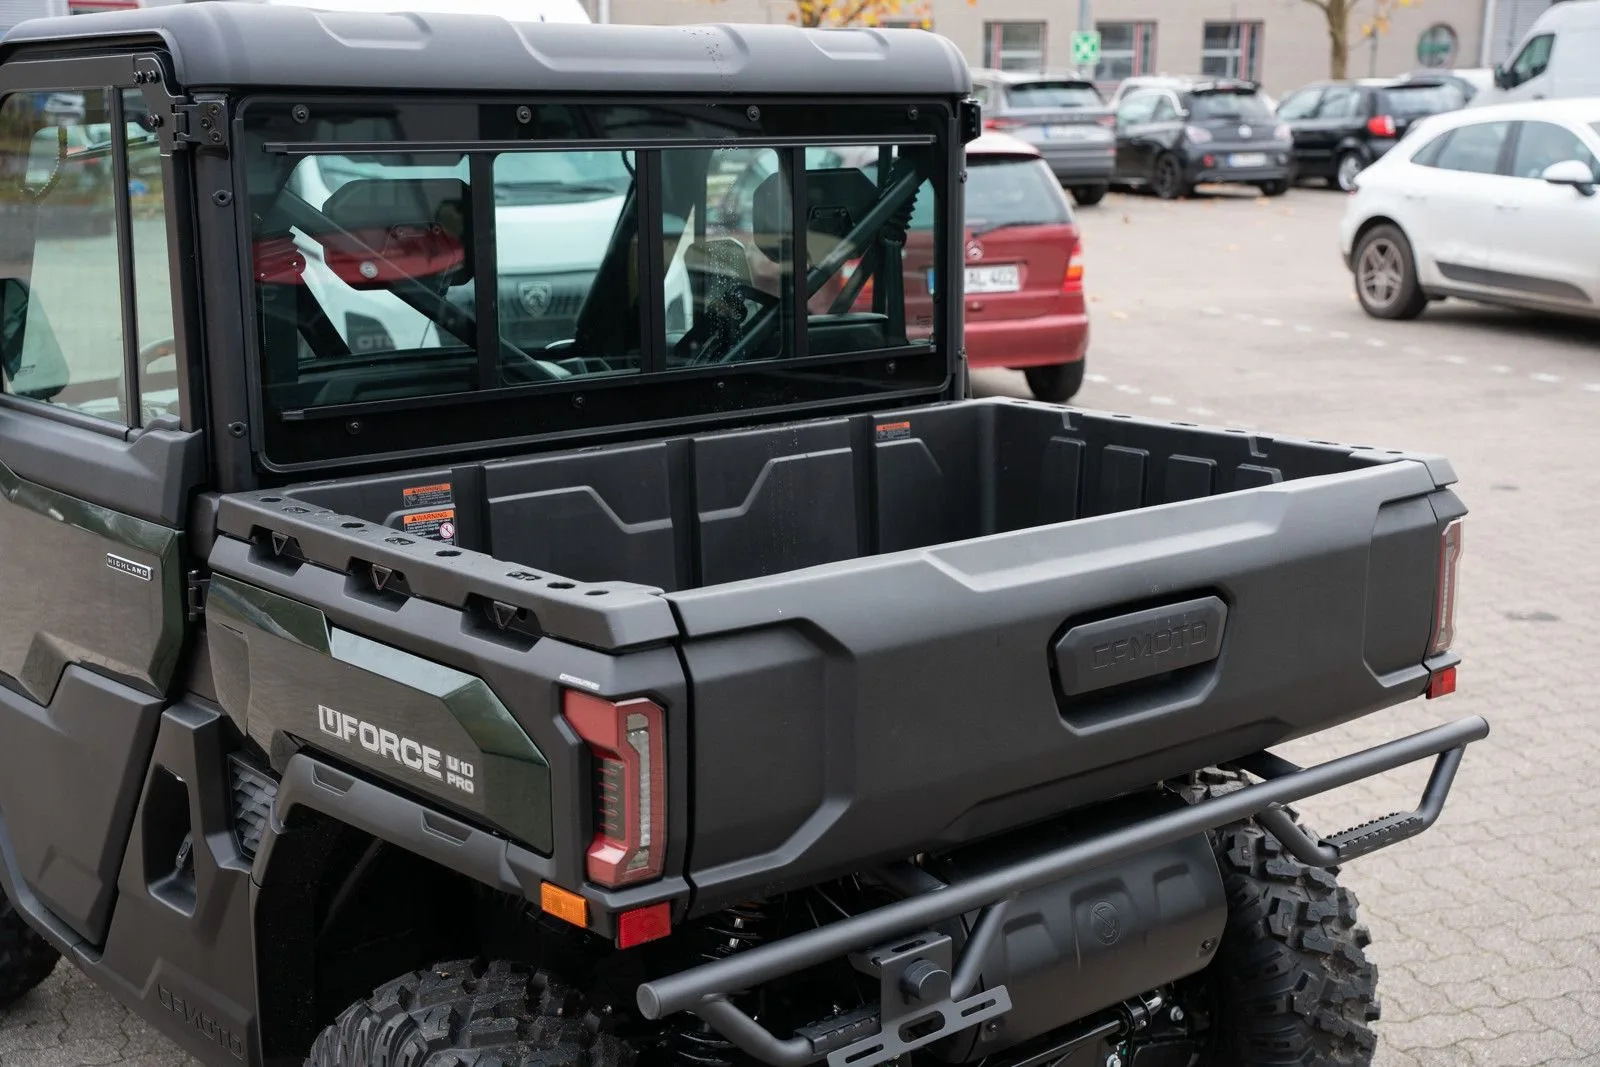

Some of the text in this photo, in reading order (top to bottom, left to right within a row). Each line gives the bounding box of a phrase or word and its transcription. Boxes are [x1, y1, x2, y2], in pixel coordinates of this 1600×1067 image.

[416, 511, 448, 520] WARNING
[107, 557, 148, 577] HIGHLAND
[1090, 620, 1208, 670] CFMOTO
[318, 704, 444, 780] UFORCE
[447, 773, 475, 794] PRO
